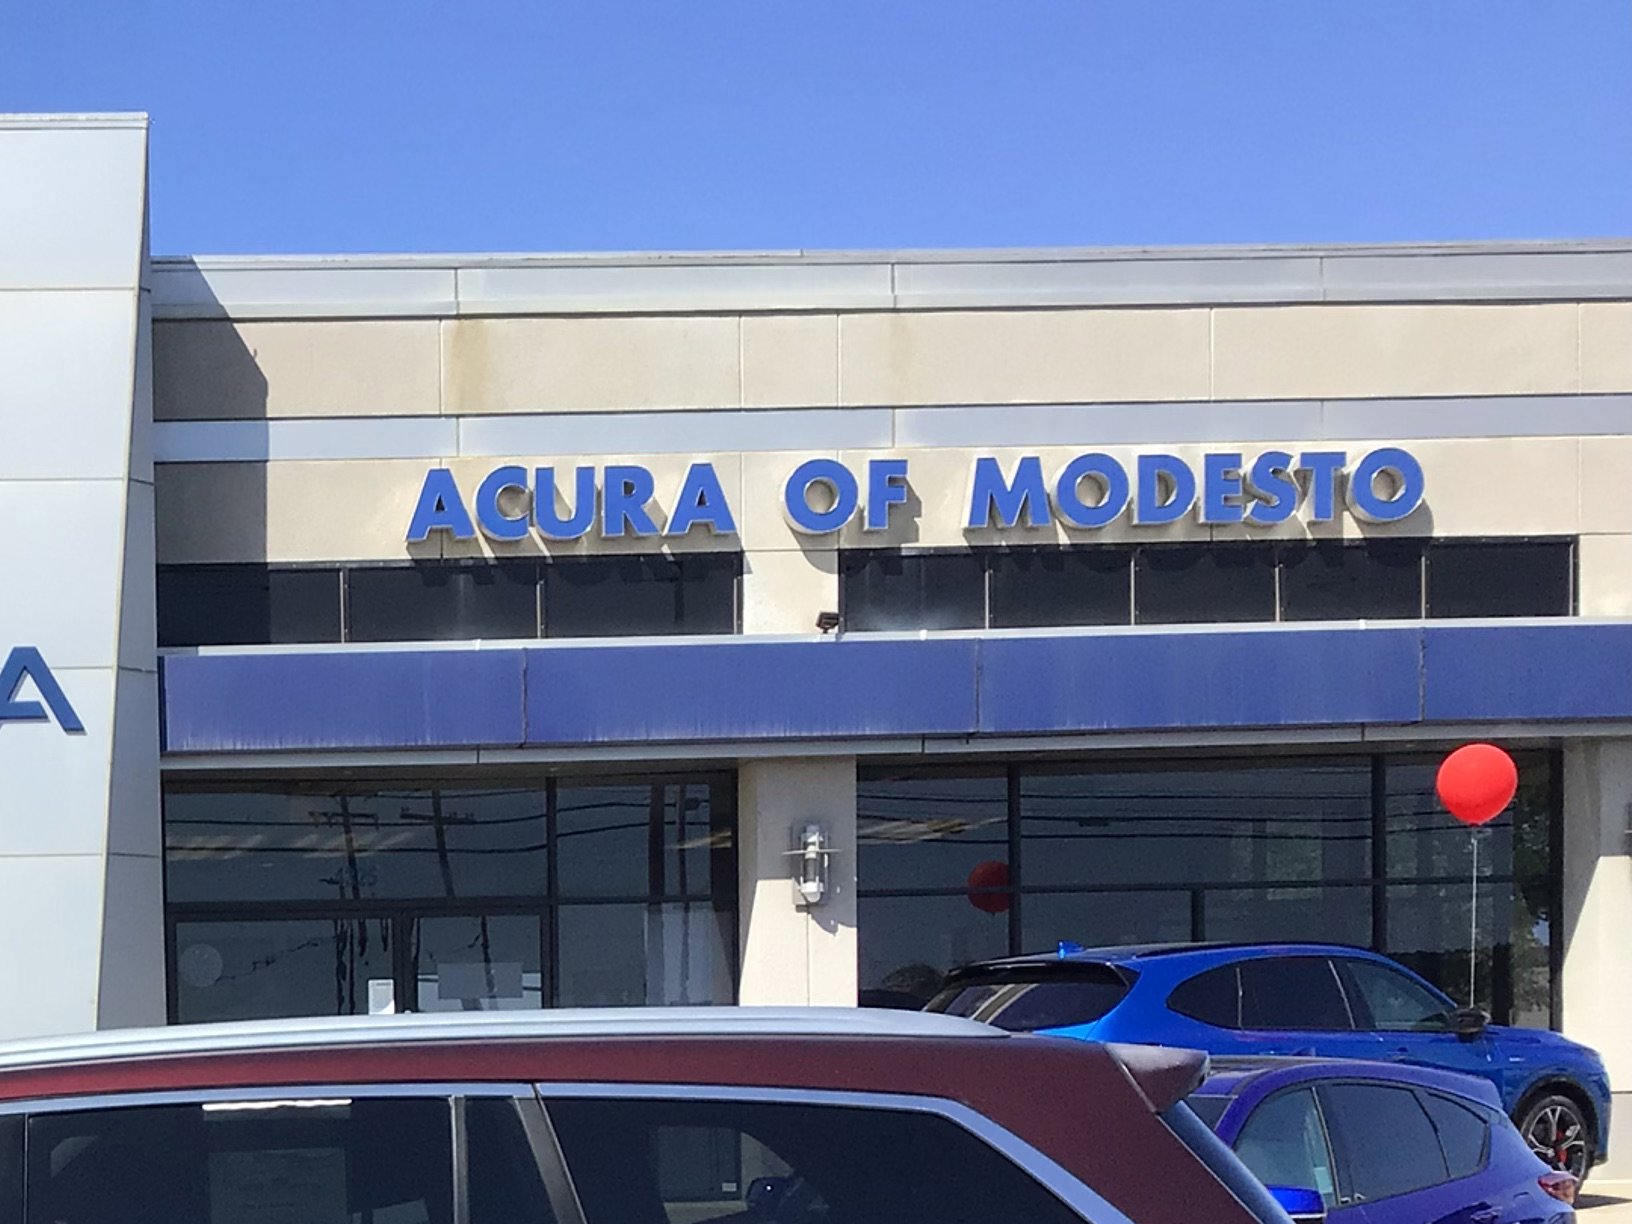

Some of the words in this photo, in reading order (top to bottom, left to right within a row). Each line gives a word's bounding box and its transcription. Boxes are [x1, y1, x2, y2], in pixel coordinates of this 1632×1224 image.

[405, 462, 741, 541] ACURA
[781, 458, 913, 534] OF
[969, 447, 1428, 529] MODESTO
